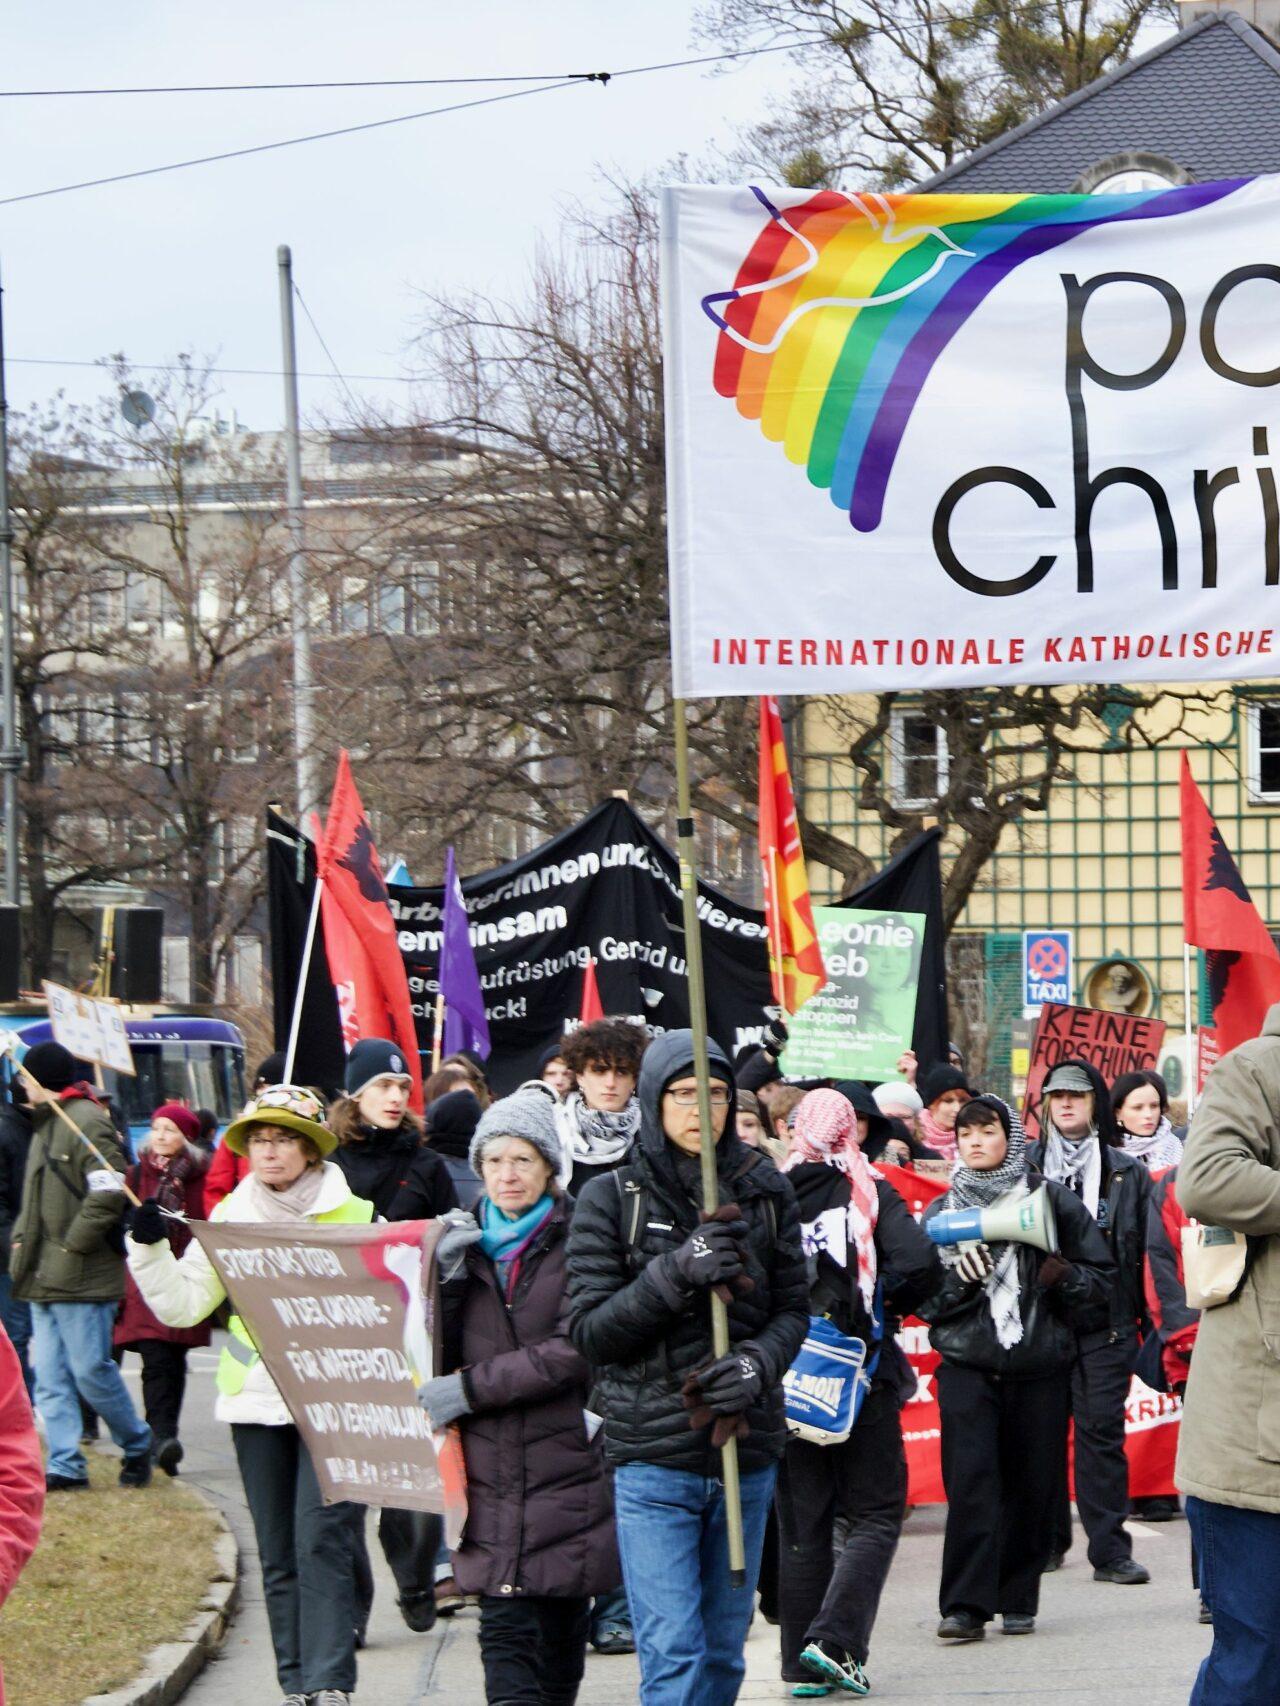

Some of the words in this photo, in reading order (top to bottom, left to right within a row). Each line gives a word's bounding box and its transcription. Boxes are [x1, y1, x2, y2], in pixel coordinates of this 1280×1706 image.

[712, 638, 1025, 666] INTERNATIONALE
[1043, 629, 1273, 663] KATHOLISCHE
[820, 918, 914, 948] eonie
[480, 945, 598, 991] ufrüstung,
[1028, 982, 1067, 1000] TAXI
[1043, 1005, 1151, 1049] KEINE
